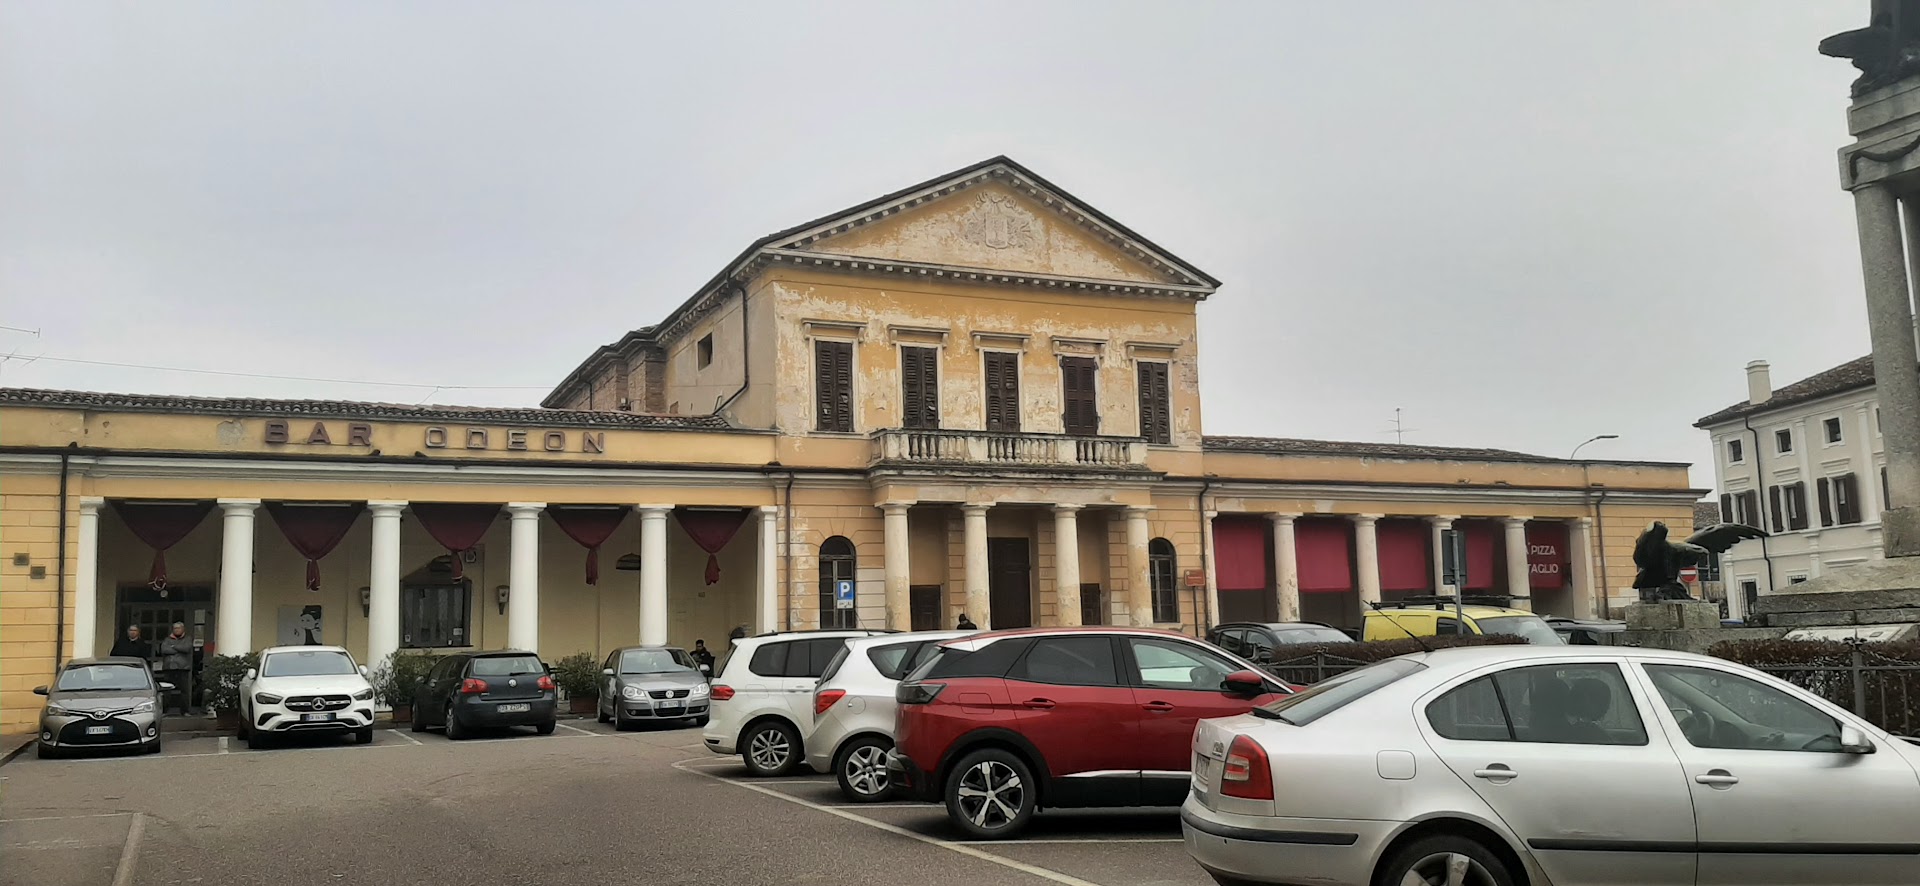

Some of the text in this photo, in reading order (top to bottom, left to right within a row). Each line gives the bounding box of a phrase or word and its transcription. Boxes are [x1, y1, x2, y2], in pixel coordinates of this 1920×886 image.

[265, 420, 605, 453] BAR ODEON
[1531, 545, 1556, 555] PIZZA
[840, 582, 850, 597] P
